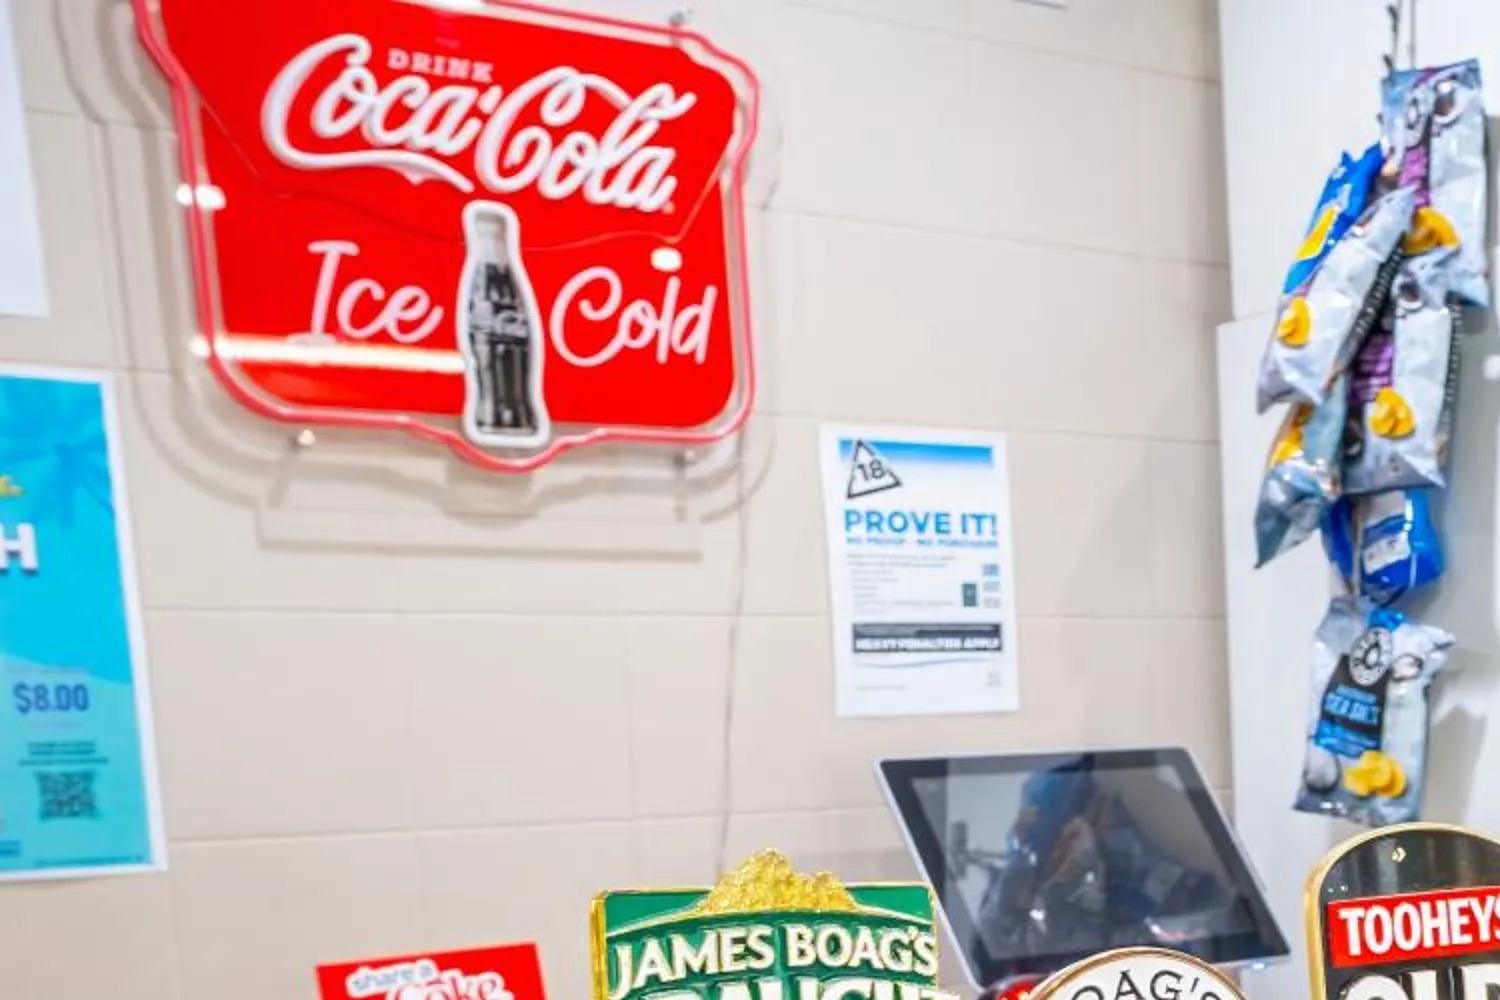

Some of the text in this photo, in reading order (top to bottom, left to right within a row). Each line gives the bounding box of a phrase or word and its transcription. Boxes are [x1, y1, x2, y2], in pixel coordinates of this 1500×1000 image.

[386, 47, 495, 83] DRINK
[287, 240, 718, 367] Ice Cold
[857, 460, 886, 482] 18
[844, 509, 998, 537] PROVE IT!
[13, 681, 91, 715] $8.00
[786, 920, 938, 977] BOAG'S
[352, 967, 414, 992] share
